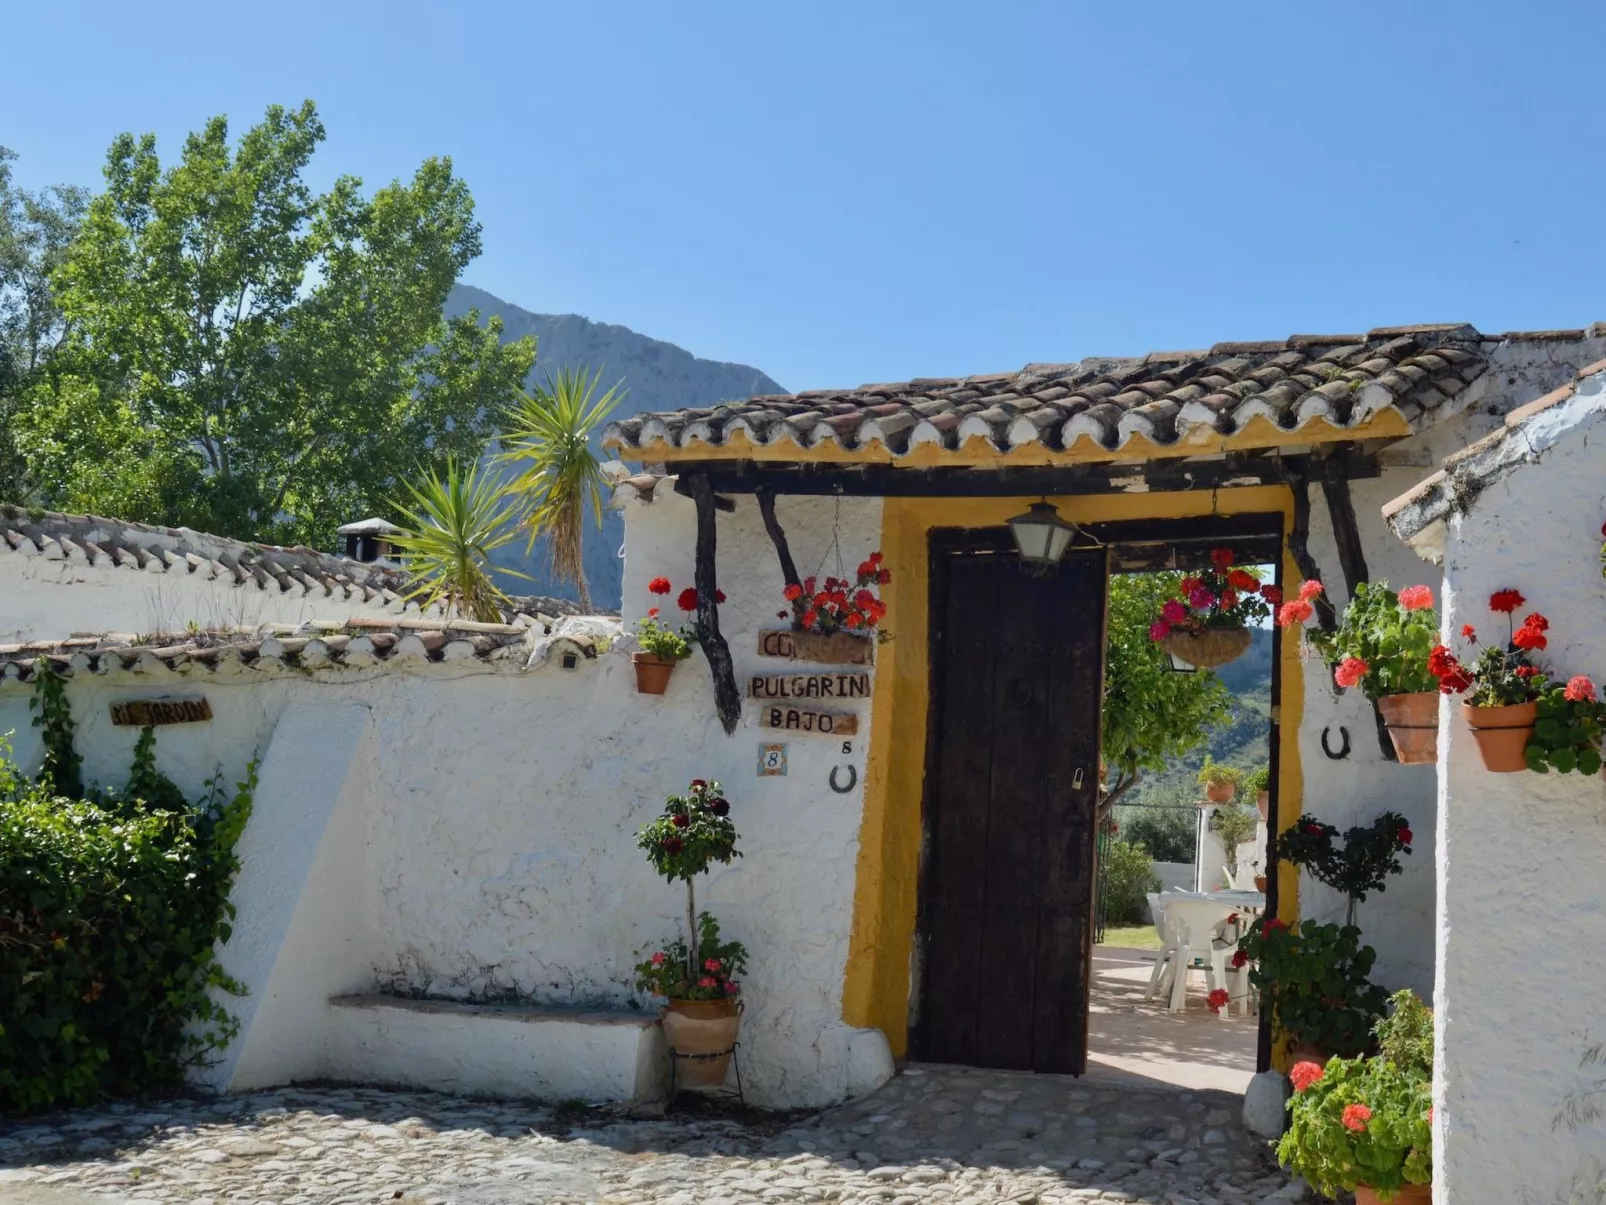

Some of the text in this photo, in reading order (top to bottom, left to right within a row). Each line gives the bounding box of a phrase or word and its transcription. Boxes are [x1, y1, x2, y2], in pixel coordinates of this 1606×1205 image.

[752, 675, 865, 698] PULGARIN
[140, 700, 206, 725] JARDIN
[770, 708, 833, 733] BAJO
[841, 741, 852, 754] 8
[767, 752, 778, 767] 8
